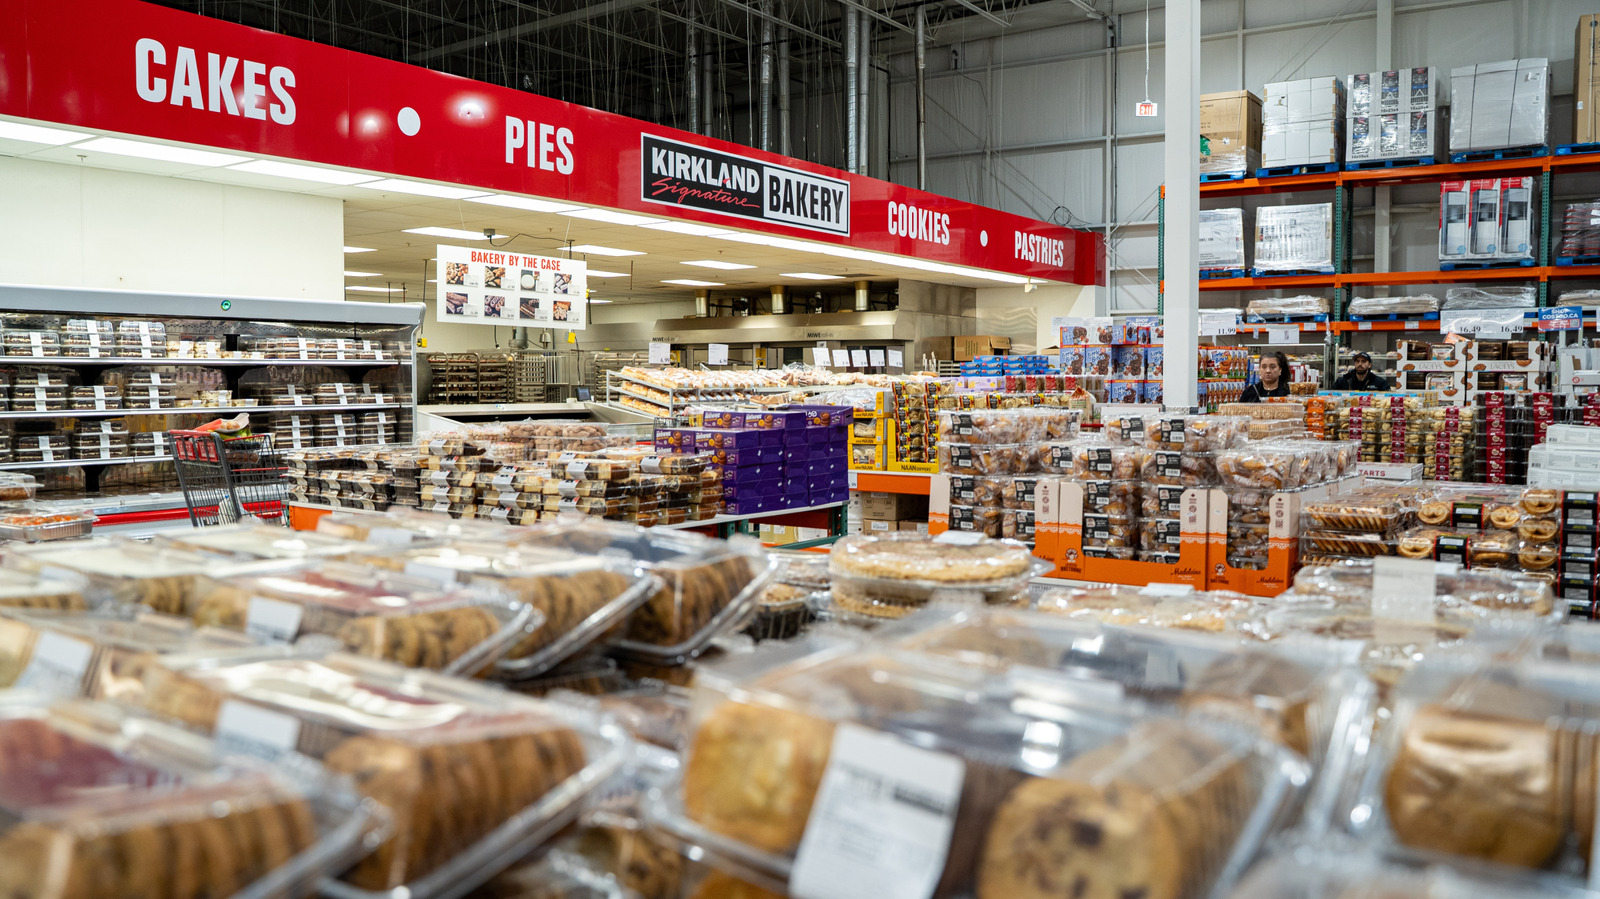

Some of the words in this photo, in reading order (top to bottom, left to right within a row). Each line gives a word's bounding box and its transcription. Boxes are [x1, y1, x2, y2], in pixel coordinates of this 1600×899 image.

[135, 38, 296, 125] CAKES
[1139, 104, 1153, 115] EXIT
[505, 115, 574, 175] PIES
[652, 147, 760, 194] KIRKLAND
[651, 177, 760, 209] Signature
[768, 174, 844, 224] BAKERY
[888, 201, 950, 246] COOKIES
[471, 251, 505, 265] BAKERY
[508, 255, 519, 266] BY
[522, 257, 537, 268] THE
[540, 259, 561, 271] CASE
[1014, 230, 1064, 268] PASTRIES
[1359, 469, 1386, 477] TARTS
